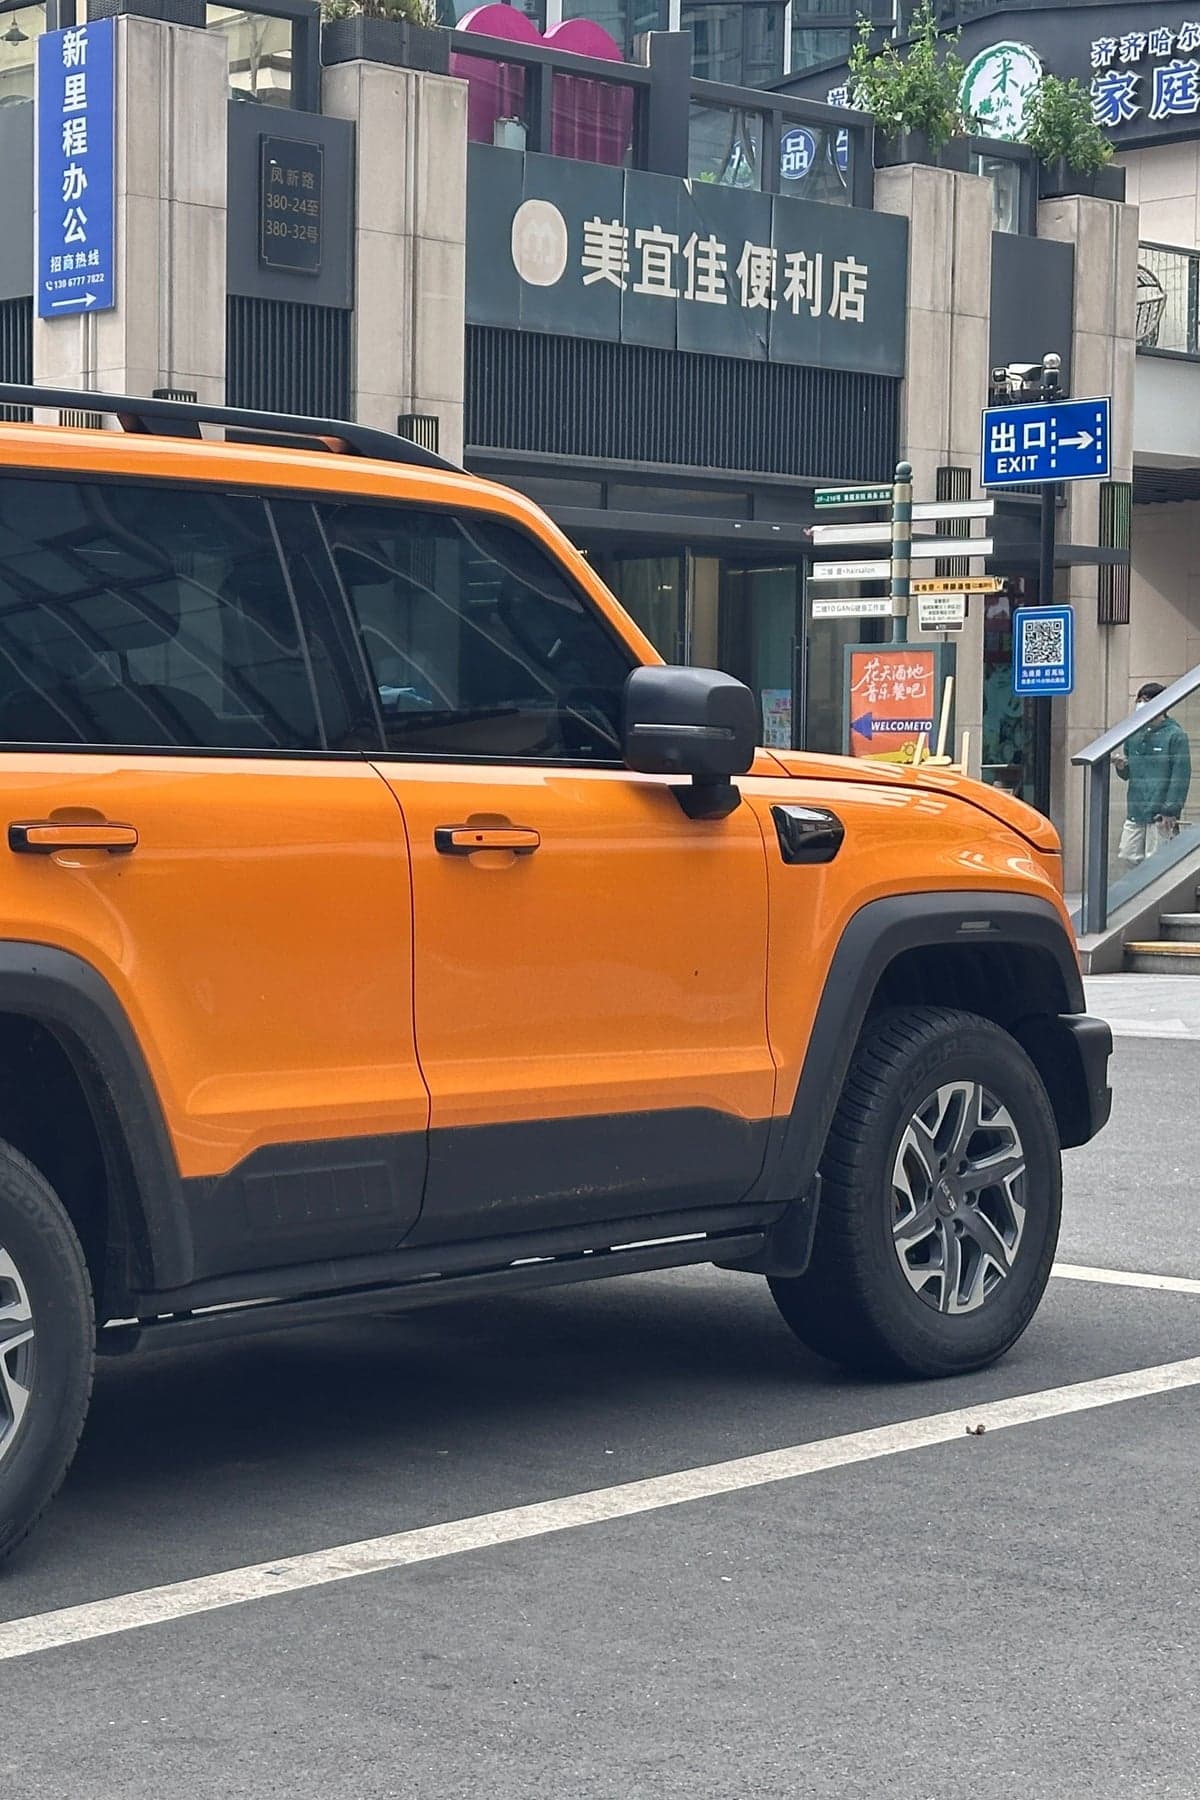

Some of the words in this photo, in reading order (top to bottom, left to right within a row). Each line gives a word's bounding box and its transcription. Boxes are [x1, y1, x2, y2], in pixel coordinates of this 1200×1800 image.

[1091, 21, 1200, 67] 齐齐哈尔
[62, 28, 88, 244] 新里程办公
[782, 134, 808, 171] 品
[271, 167, 315, 189] 凤新路
[266, 193, 319, 217] 380-24至
[266, 220, 319, 244] 380-32号
[50, 249, 99, 272] 招商热线
[580, 216, 868, 323] 美宜佳便利店
[990, 422, 1046, 453] 出口
[997, 455, 1038, 474] EXIT
[850, 657, 934, 691] 花天酒地
